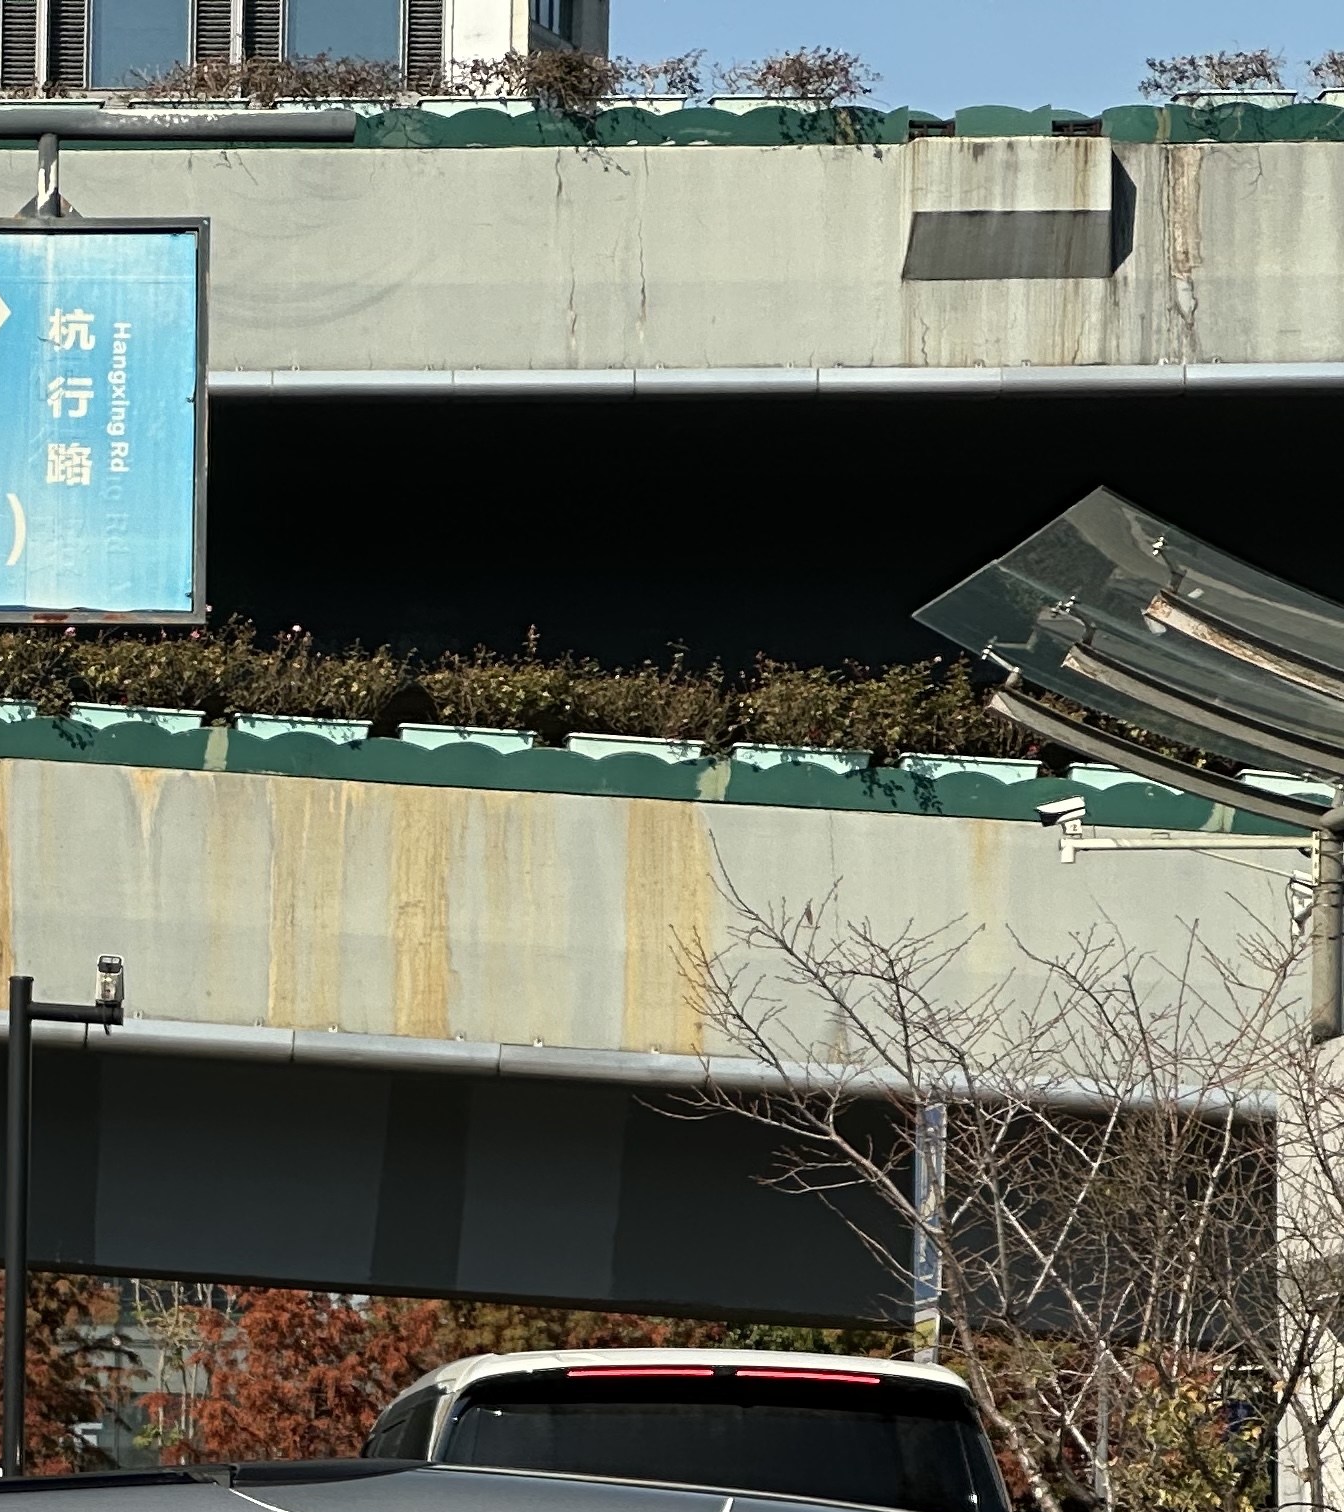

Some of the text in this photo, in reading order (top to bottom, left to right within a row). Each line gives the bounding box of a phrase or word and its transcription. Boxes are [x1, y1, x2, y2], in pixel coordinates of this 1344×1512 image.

[45, 308, 96, 486] 杭行路
[106, 322, 132, 436] Hangxing
[109, 441, 130, 473] Rd
